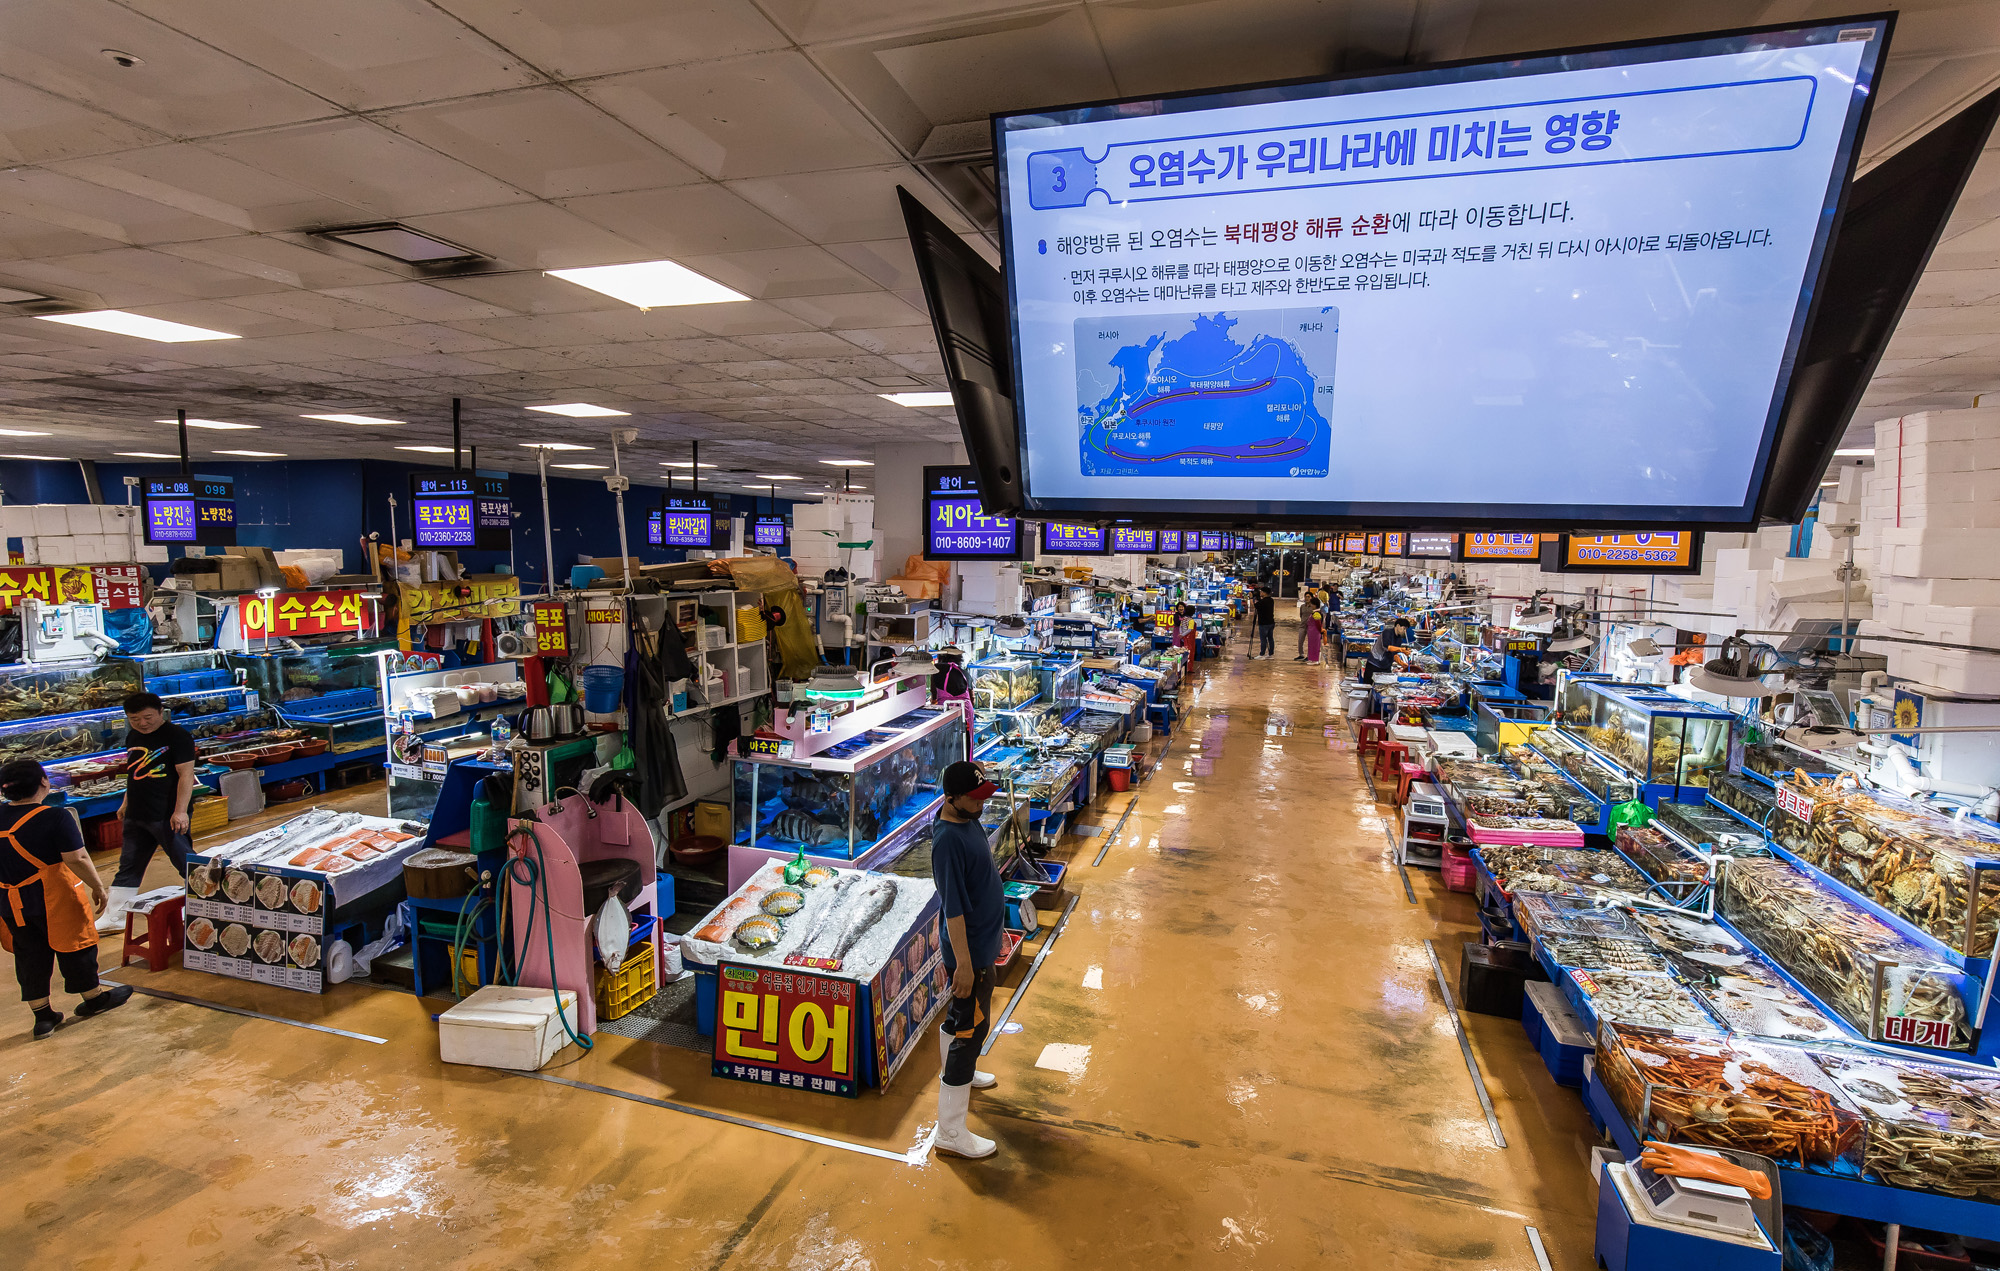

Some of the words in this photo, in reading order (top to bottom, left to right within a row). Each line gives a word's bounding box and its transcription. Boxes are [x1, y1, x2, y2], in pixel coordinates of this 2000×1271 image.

[1051, 166, 1067, 193] 3
[1129, 144, 1248, 188] 오염수가
[1255, 128, 1417, 178] 우리나라에
[1428, 119, 1532, 162] 미치는
[1544, 109, 1620, 154] 영향
[1057, 233, 1121, 255] 해양방류
[1127, 230, 1143, 251] 된
[1150, 226, 1218, 248] 오염수는
[1223, 219, 1298, 245] 북태평양
[1306, 216, 1344, 239] 해류
[1351, 211, 1411, 237] 순환에
[1419, 208, 1458, 232] 따라
[1466, 200, 1574, 229] 이동합니다.
[1070, 269, 1095, 285] 먼저
[1098, 266, 1148, 284] 쿠루시오
[1151, 263, 1190, 281] 해류를
[1193, 261, 1220, 279] 따라
[1223, 257, 1291, 277] 태평양으로
[1294, 254, 1337, 273] 이동한
[1339, 251, 1398, 270] 오염수는
[1402, 247, 1448, 266] 미국과
[1451, 244, 1497, 263] 적도를
[1501, 242, 1533, 261] 거친
[1536, 241, 1553, 259] 뒤
[1557, 238, 1590, 257] 다시
[1594, 235, 1660, 256] 아시아로
[1665, 228, 1773, 252] 되돌아옵니다.
[1073, 289, 1098, 305] 이후
[1100, 287, 1150, 304] 오염수는
[1153, 283, 1218, 301] 대마난류를
[1221, 281, 1248, 298] 타고
[1250, 278, 1292, 297] 제주와
[1295, 276, 1351, 294] 한반도로
[1354, 271, 1430, 292] 유입됩니다.
[1299, 323, 1324, 333] 캐나다
[1098, 331, 1120, 341] 러시아
[1317, 385, 1334, 395] 미국
[1276, 414, 1291, 423] 해류
[1203, 422, 1225, 431] 태평양
[173, 482, 189, 493] 098
[204, 484, 226, 495] 098
[450, 480, 468, 491] 115
[484, 482, 503, 493] 115
[940, 476, 962, 490] 활어
[480, 502, 509, 516] 목포상회
[692, 499, 707, 508] 114
[153, 505, 184, 526] 노량진
[201, 507, 227, 522] 노량진
[419, 505, 470, 525] 목포상회
[668, 517, 708, 535] 부산자갈치
[419, 531, 472, 542] 010-2360-2258
[935, 536, 1011, 549] 010-8609-1407
[1050, 540, 1100, 548] 010-3202-9395
[1578, 548, 1678, 562] 010-2258-5362
[245, 593, 363, 633] 여수수산
[536, 608, 564, 628] 목포
[537, 631, 566, 651] 상회
[749, 740, 779, 754] 아수산
[1777, 787, 1810, 822] 킹크랩
[806, 957, 838, 969] 민어
[762, 970, 794, 993] 여름철
[796, 975, 817, 998] 인기
[819, 980, 851, 1002] 보양식
[722, 990, 850, 1074] 민어
[1884, 1015, 1952, 1047] 대게
[873, 997, 889, 1087] 세아수산
[733, 1065, 773, 1083] 부위별
[779, 1071, 805, 1088] 분할
[810, 1077, 837, 1093] 판매
